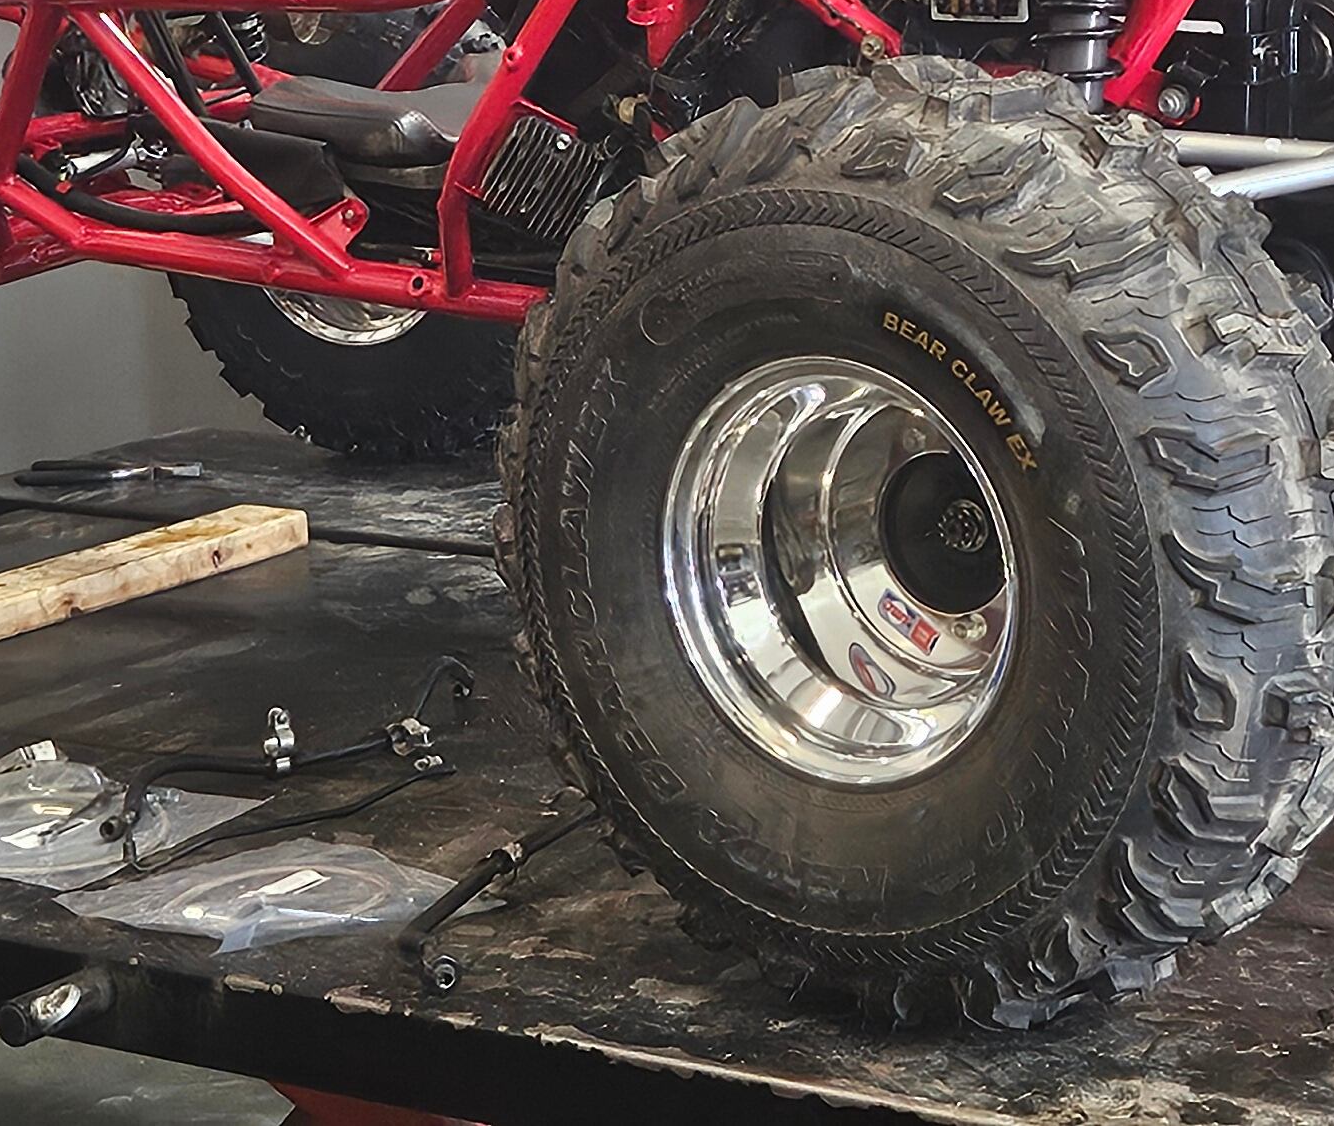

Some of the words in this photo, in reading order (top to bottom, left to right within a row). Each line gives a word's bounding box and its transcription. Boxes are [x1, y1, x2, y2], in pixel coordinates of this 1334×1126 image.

[883, 312, 947, 362] BEAR
[951, 359, 1012, 427] CLAW
[1006, 433, 1038, 471] EX
